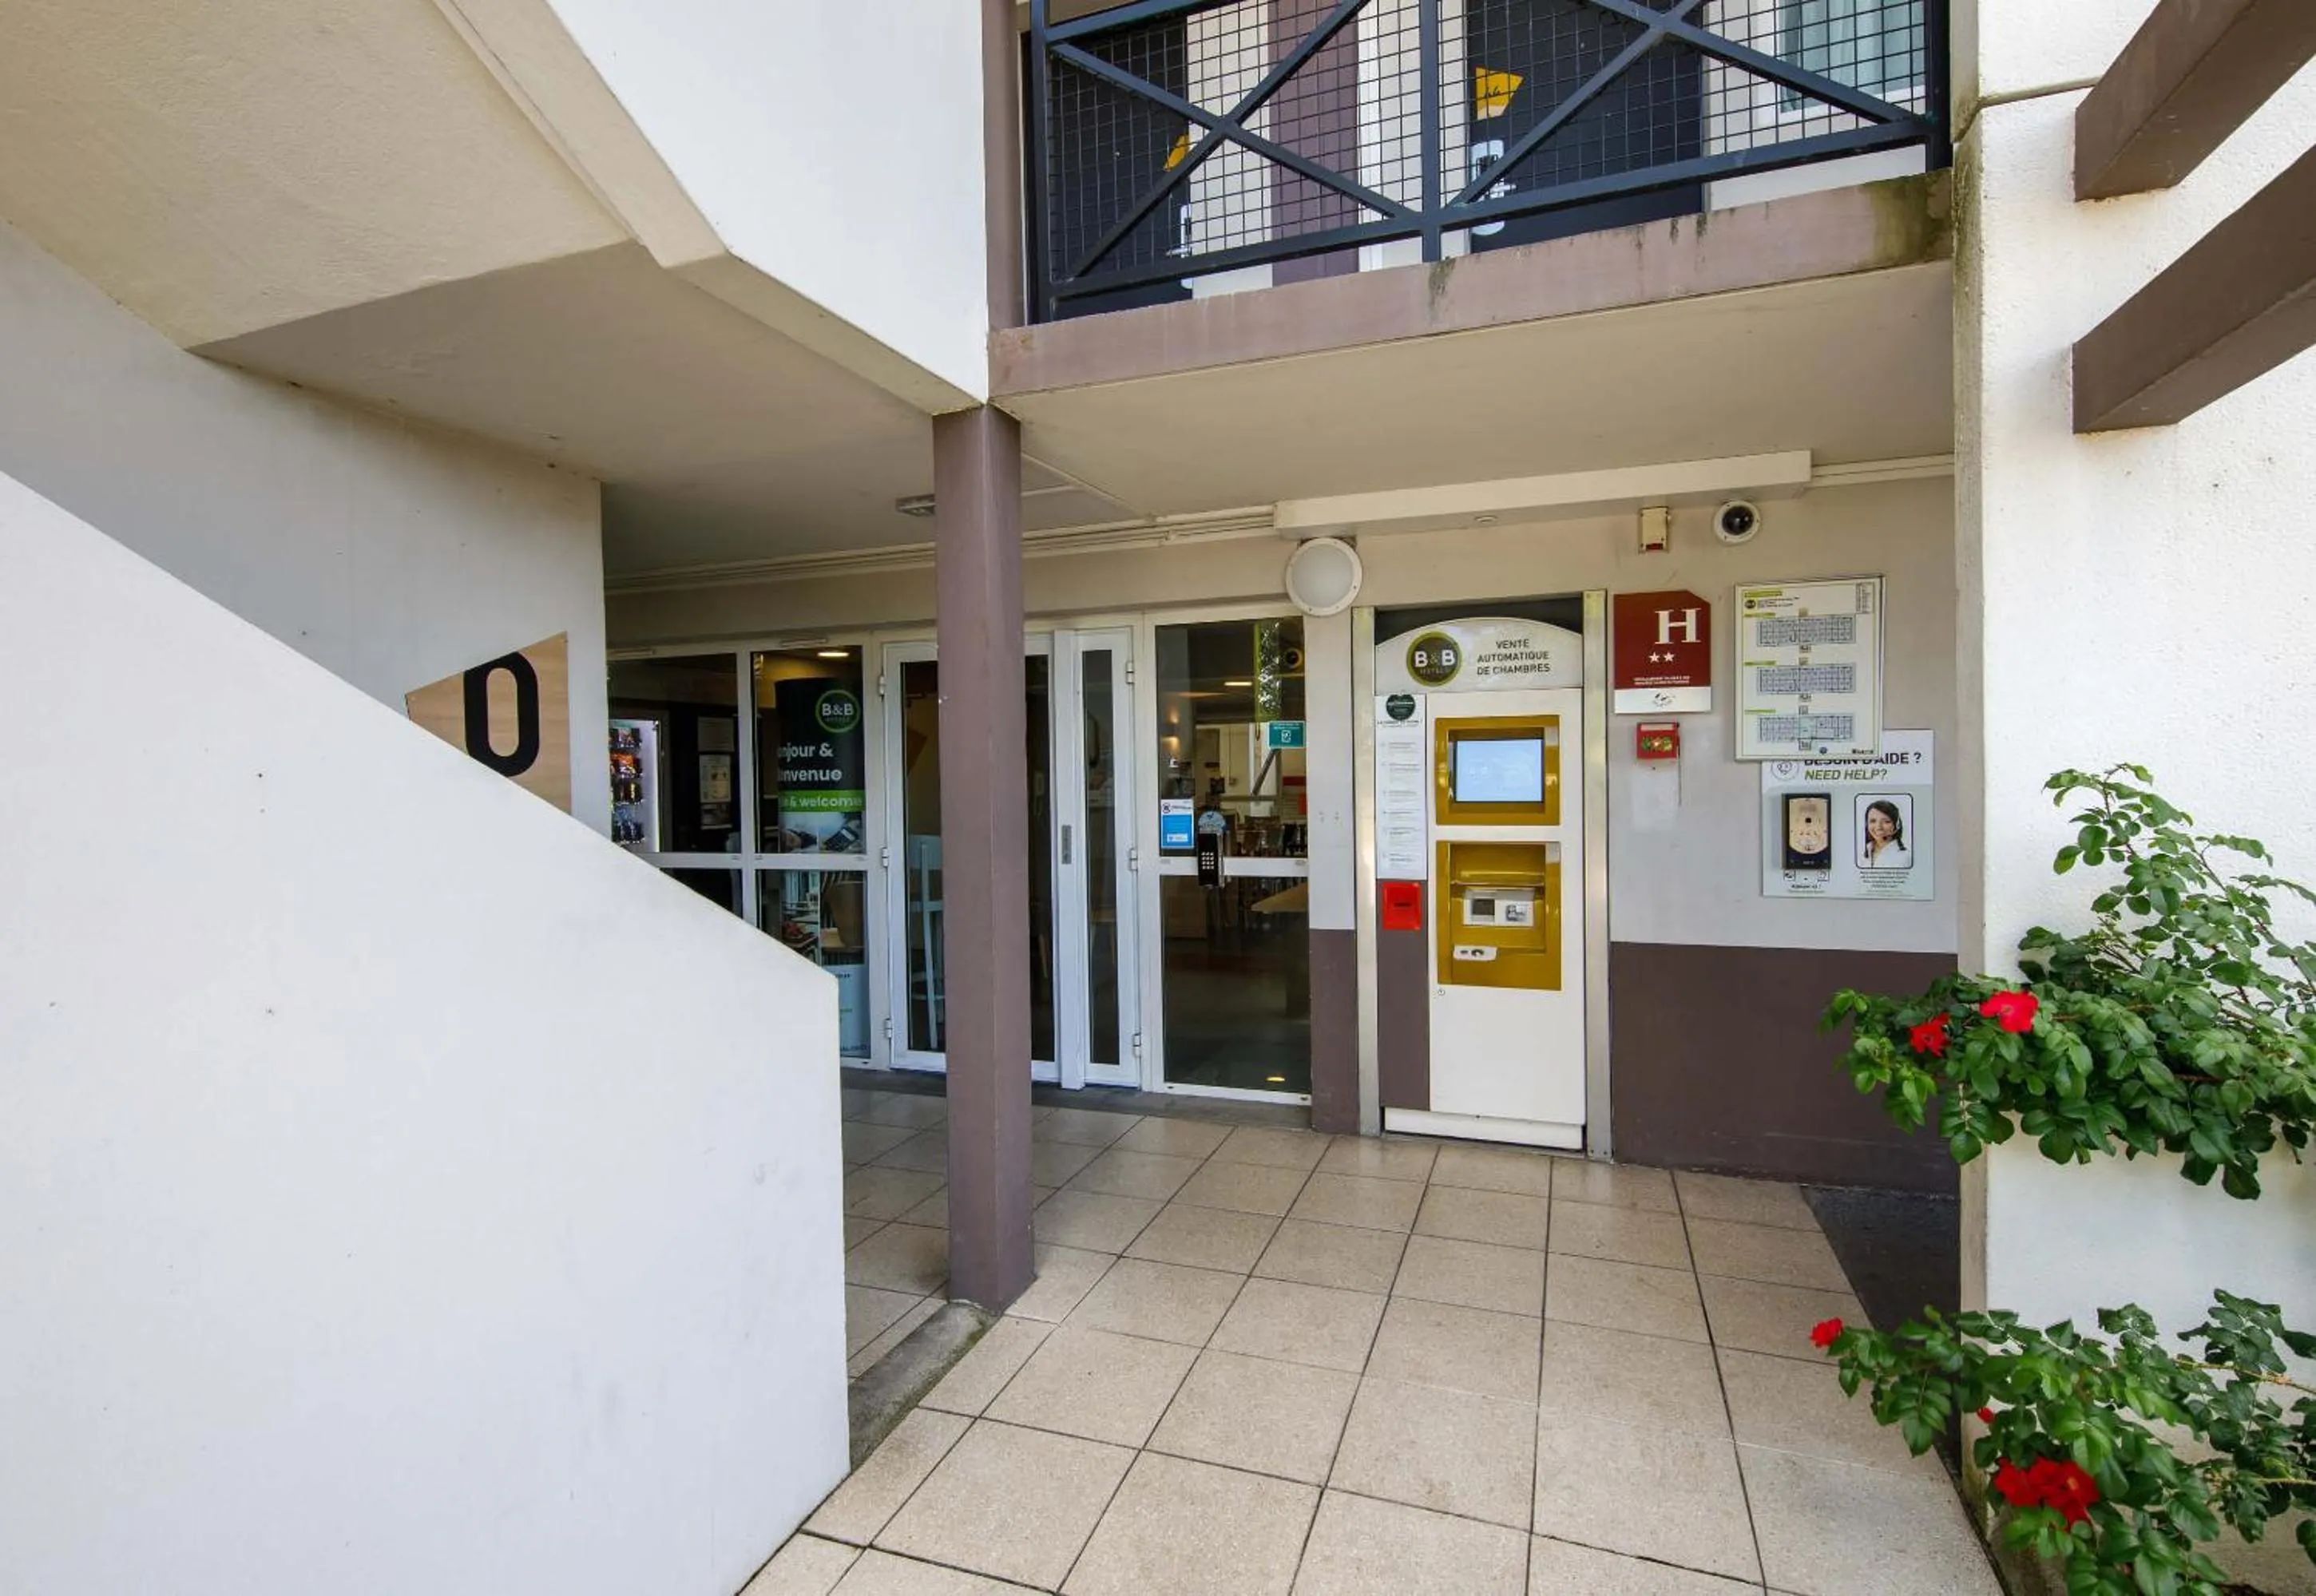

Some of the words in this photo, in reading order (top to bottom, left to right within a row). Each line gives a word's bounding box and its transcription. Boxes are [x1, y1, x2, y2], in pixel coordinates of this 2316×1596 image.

[1655, 608, 1702, 644] H
[1496, 639, 1529, 649] VENTE
[1414, 649, 1456, 667] B&B
[1477, 651, 1550, 663] AUTOMATIQUE
[1477, 667, 1490, 675] DE
[1493, 663, 1551, 675] CHAMBRES
[822, 703, 855, 717] B&B
[819, 743, 834, 758] &
[1805, 769, 1841, 780] NEED
[1843, 769, 1887, 780] HELP?
